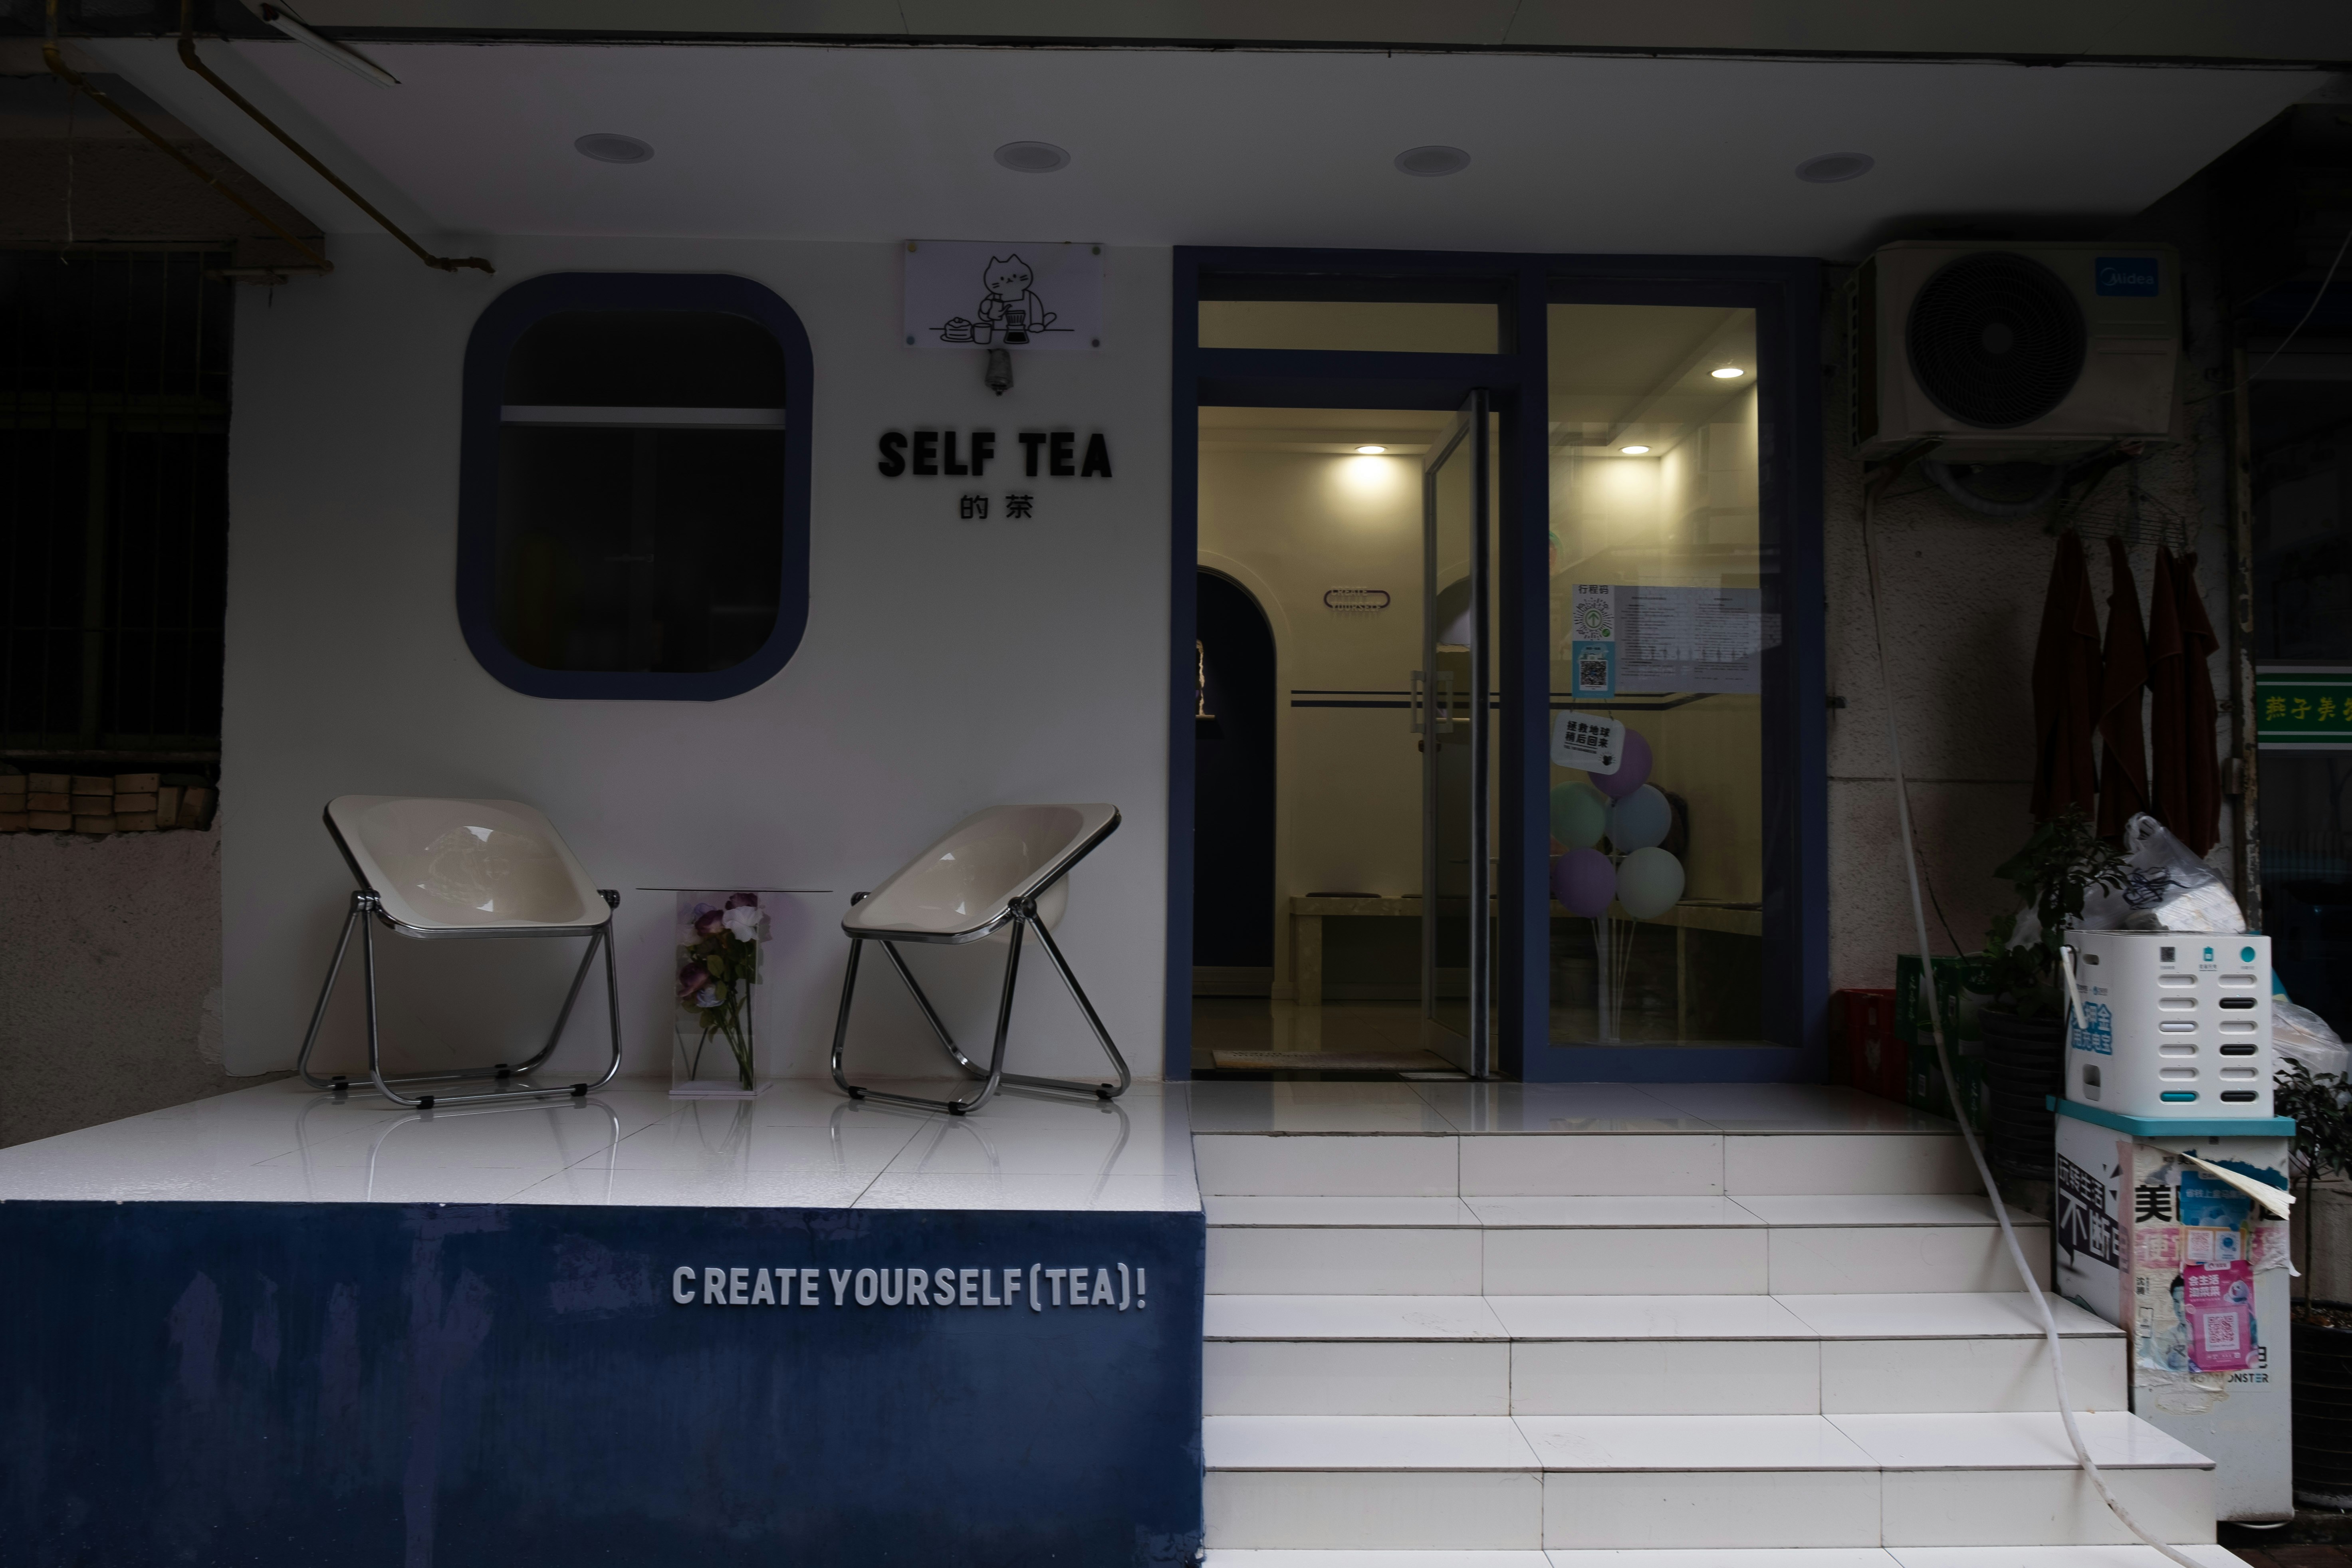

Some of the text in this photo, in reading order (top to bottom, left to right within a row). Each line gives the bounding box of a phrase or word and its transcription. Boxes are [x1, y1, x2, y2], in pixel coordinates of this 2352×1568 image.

[2106, 271, 2154, 285] Midea
[879, 431, 1112, 477] SELF TEA
[1331, 587, 1368, 596] CREATE
[1578, 585, 1609, 594] 行程码
[1332, 602, 1382, 612] YOURSELF
[1567, 721, 1610, 737] 拯救地球
[1565, 731, 1608, 748] 稍后回来
[2059, 1157, 2103, 1209] 玩转生活
[672, 1266, 819, 1306] CREATE
[2188, 1275, 2219, 1286] 会生活
[2227, 1373, 2269, 1383] ONSTER
